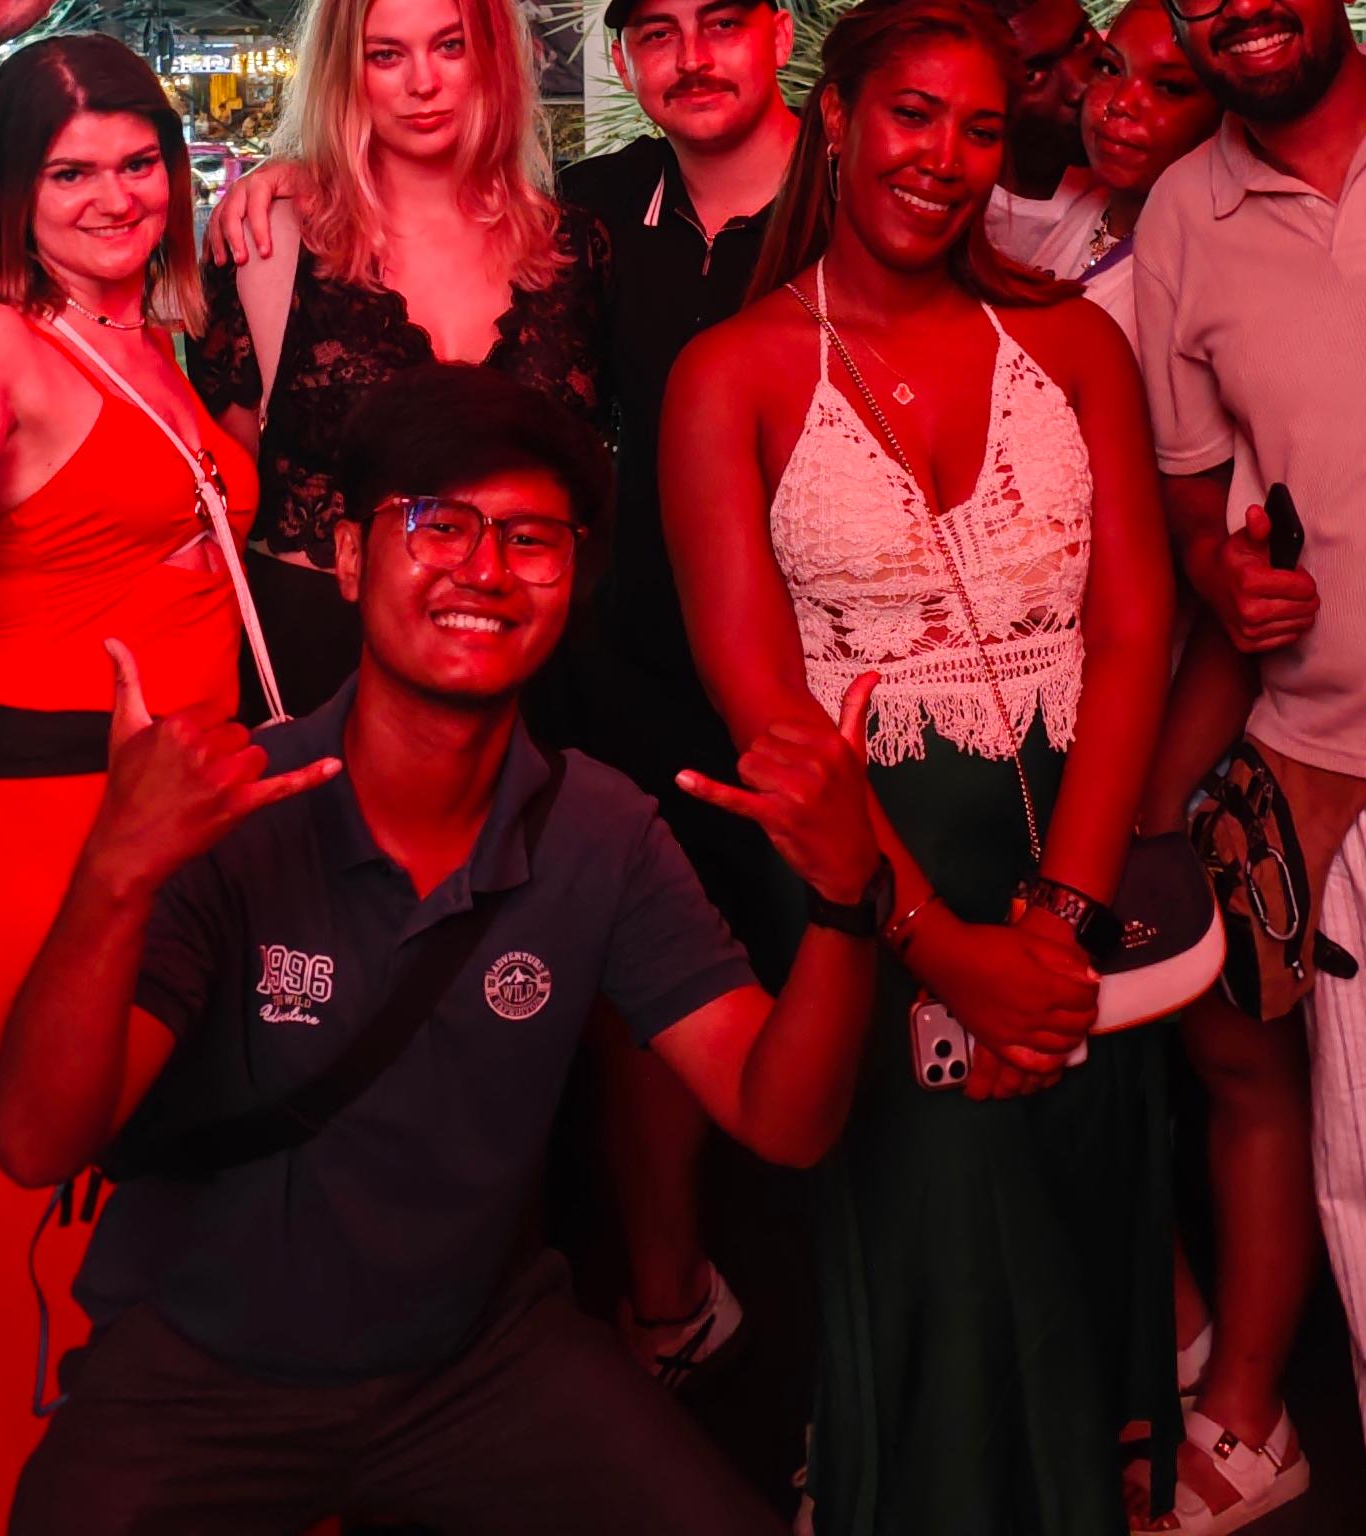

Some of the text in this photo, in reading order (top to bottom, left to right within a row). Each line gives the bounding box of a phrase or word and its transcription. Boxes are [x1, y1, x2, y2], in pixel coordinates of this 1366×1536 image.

[256, 944, 335, 1003] 1996
[284, 994, 312, 1008] WILD
[501, 983, 535, 1002] WILD
